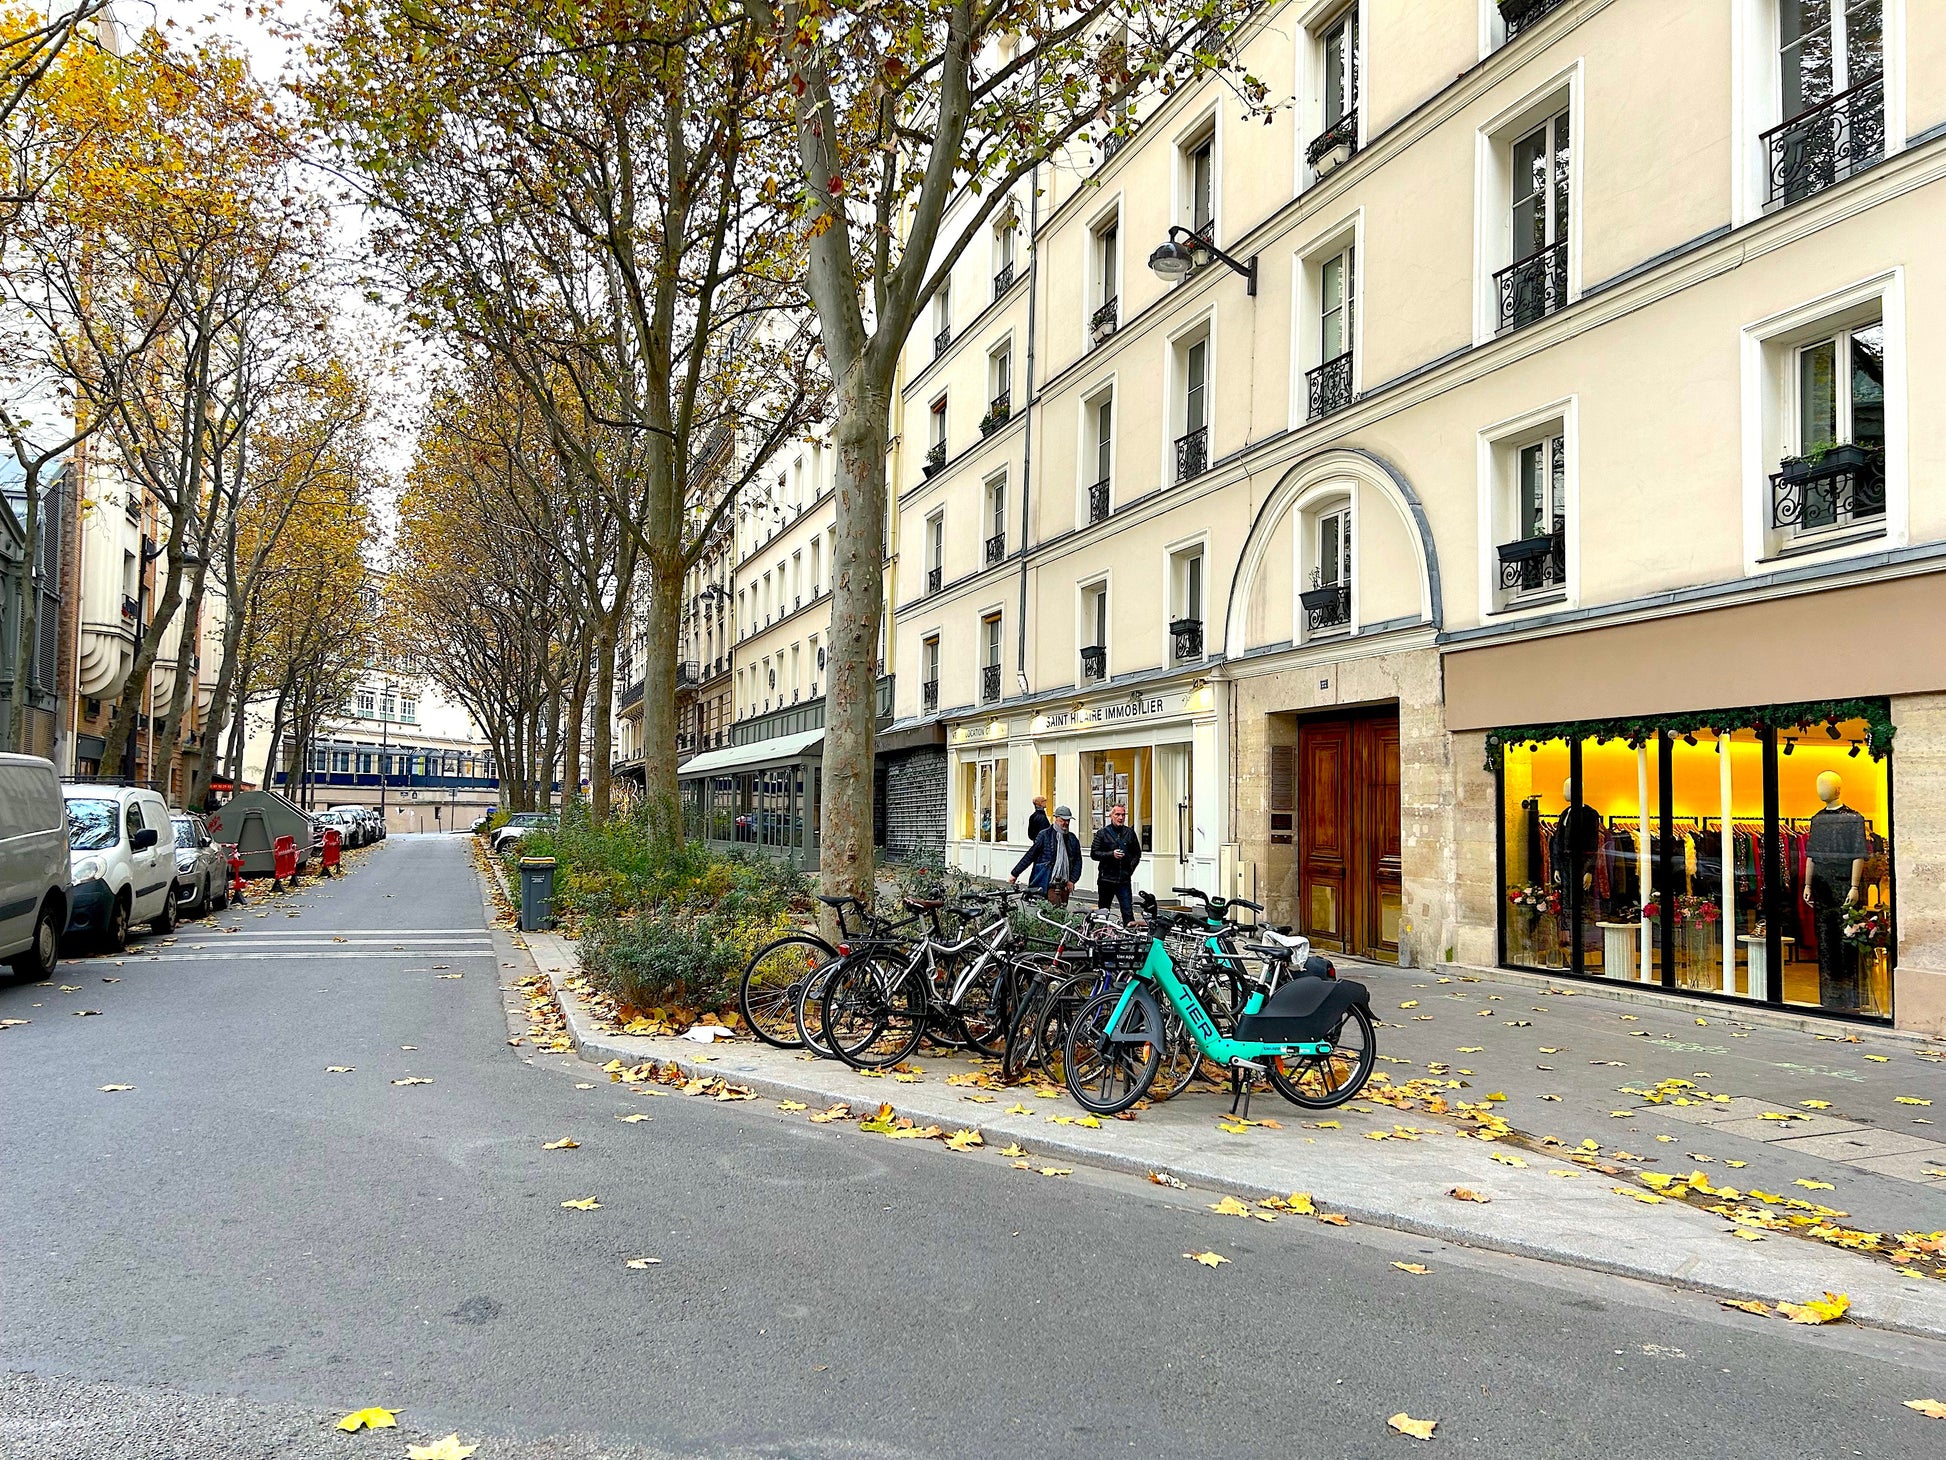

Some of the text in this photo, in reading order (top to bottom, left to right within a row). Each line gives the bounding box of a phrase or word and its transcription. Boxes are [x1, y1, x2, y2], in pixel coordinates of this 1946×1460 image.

[1046, 714, 1068, 728] SAINT
[1105, 699, 1163, 720] IMMOBILIER
[1179, 986, 1213, 1041] TIER
